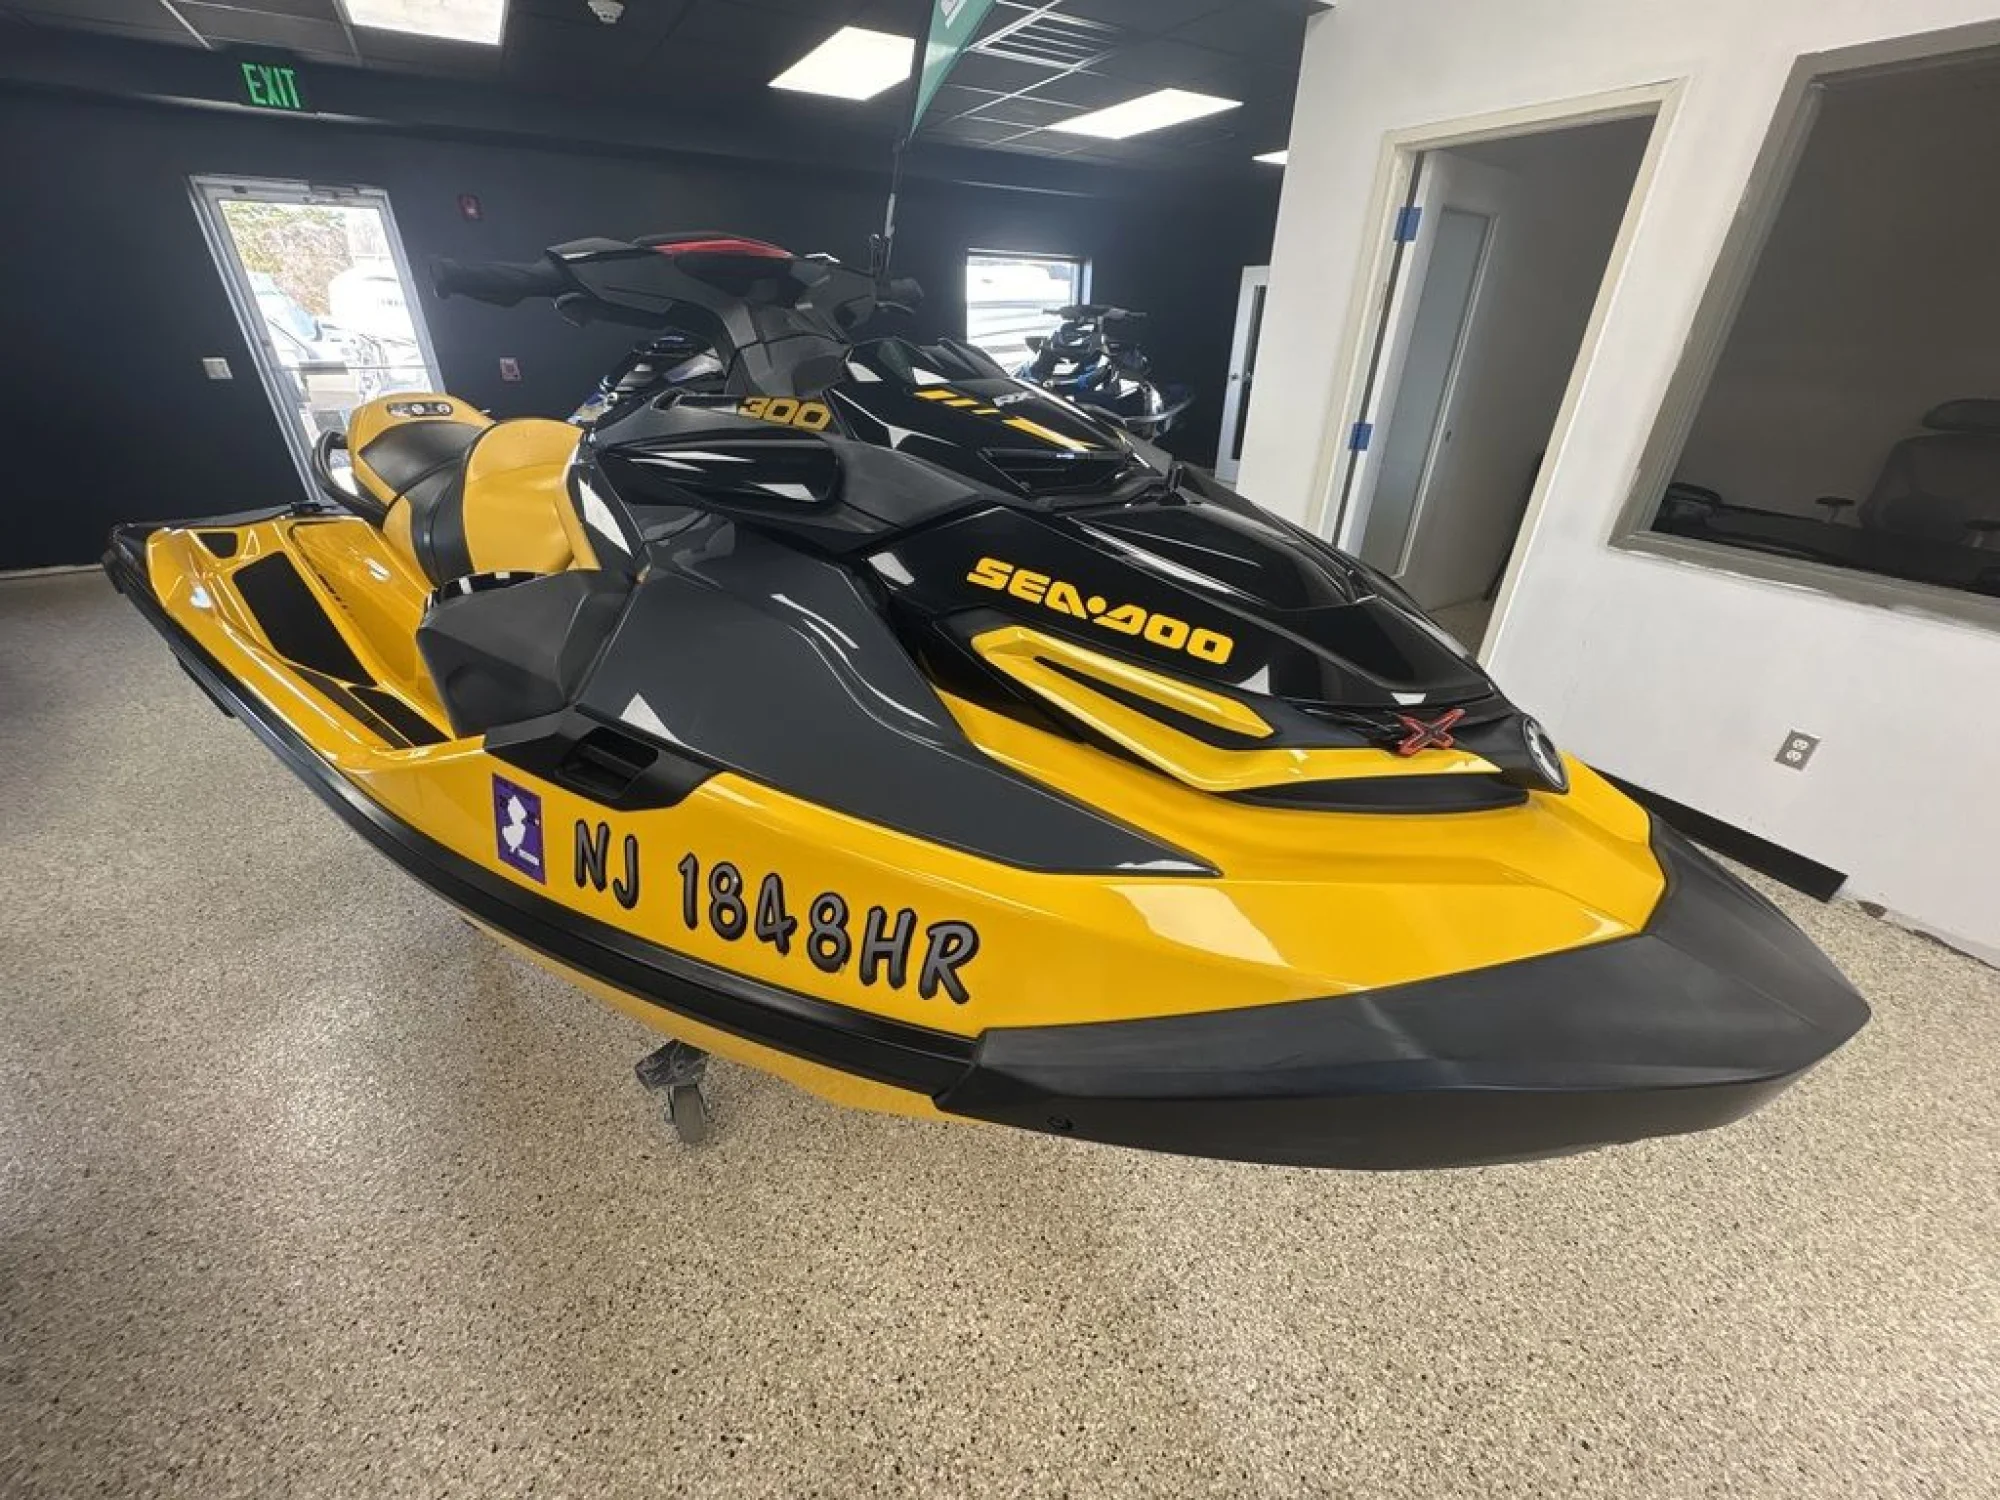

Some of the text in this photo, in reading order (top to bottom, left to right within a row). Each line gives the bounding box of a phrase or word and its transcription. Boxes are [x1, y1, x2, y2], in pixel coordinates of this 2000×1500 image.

[241, 62, 300, 108] EXIT
[738, 397, 831, 431] 300
[574, 819, 980, 1004] NJ 1848HR
